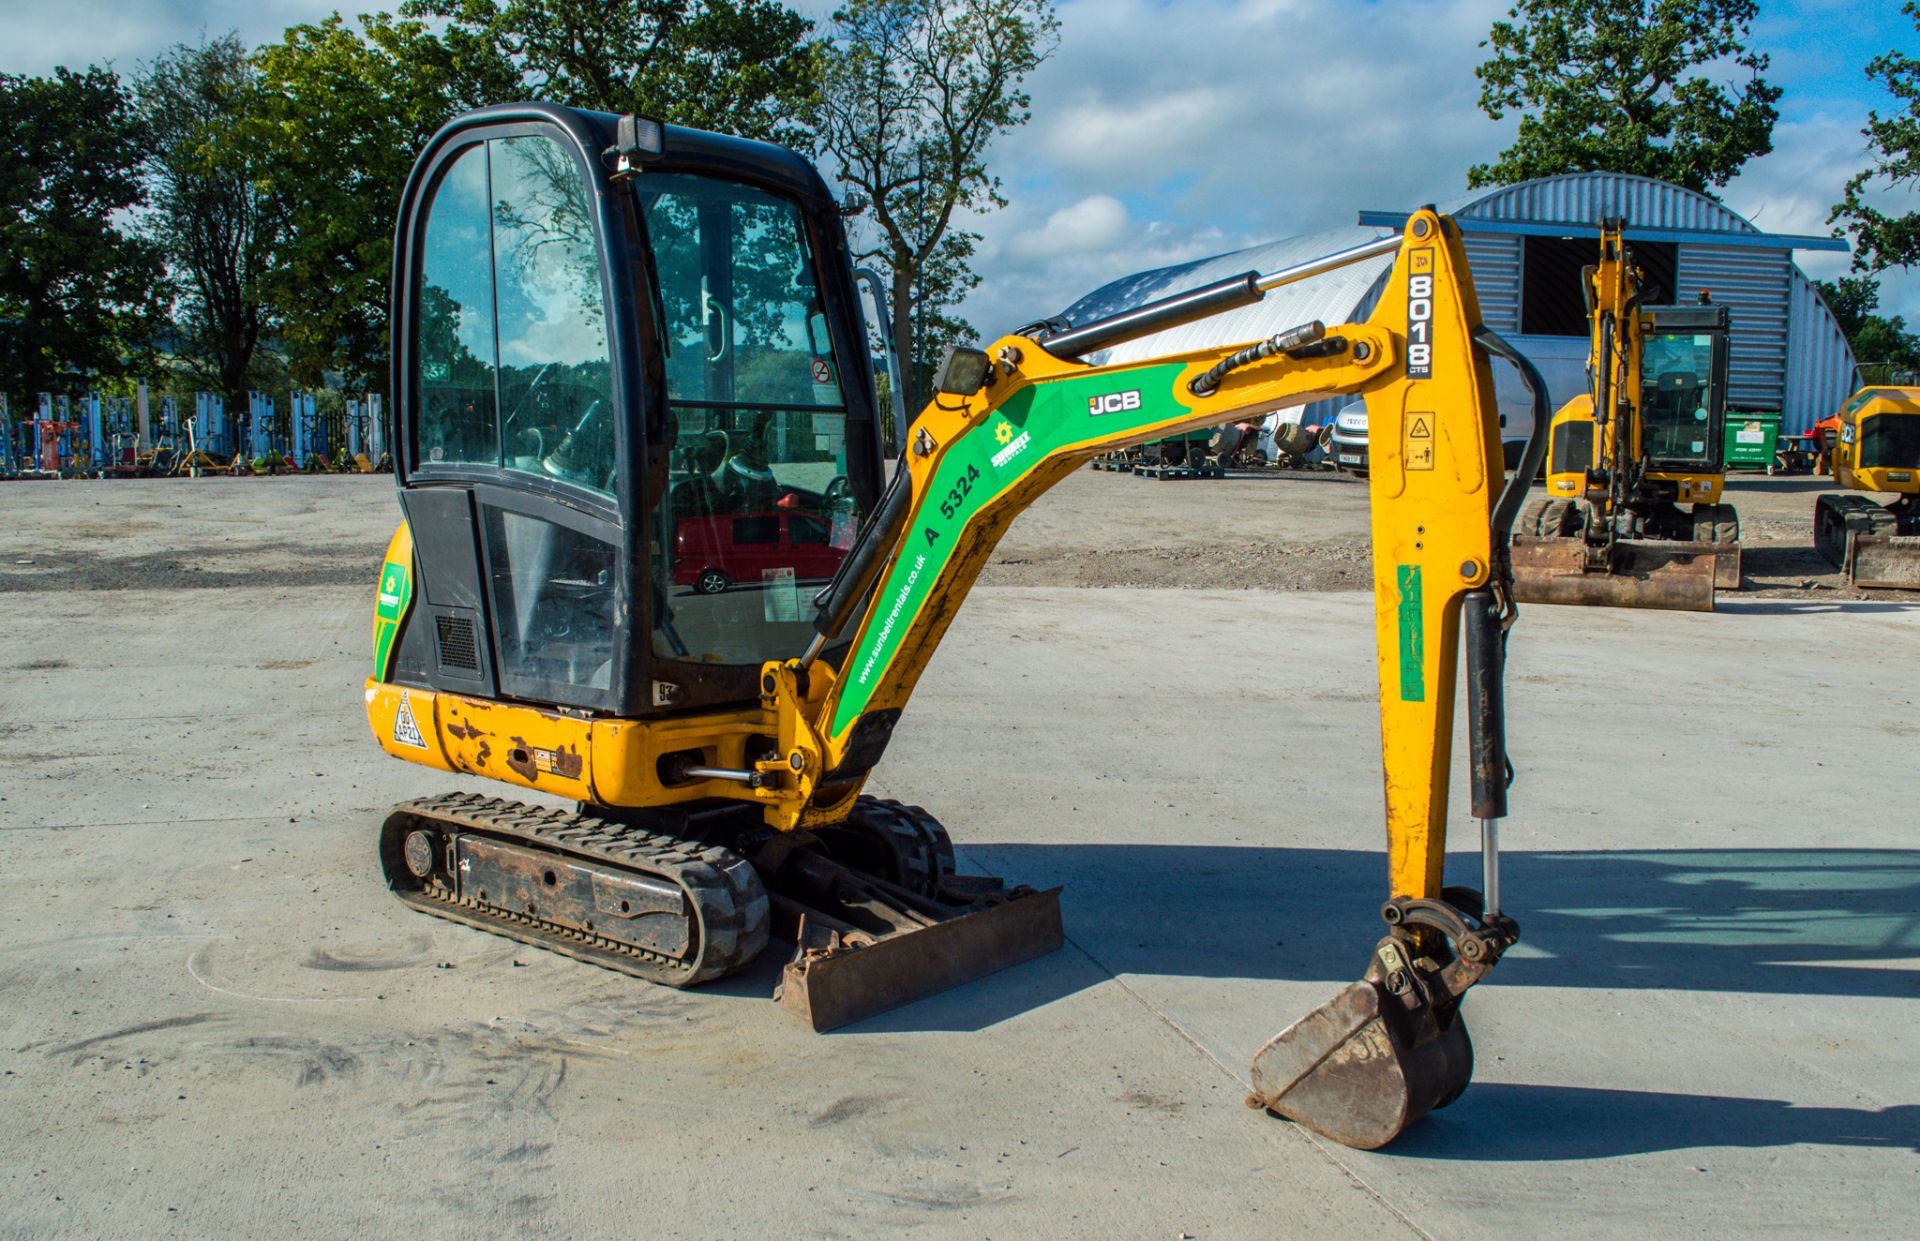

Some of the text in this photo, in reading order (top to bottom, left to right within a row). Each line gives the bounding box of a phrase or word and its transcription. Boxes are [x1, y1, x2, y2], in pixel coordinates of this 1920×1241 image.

[1408, 276, 1432, 366] 8018
[1409, 366, 1429, 374] CTS
[1089, 390, 1141, 415] JCB
[991, 430, 1031, 467] SUNBELT
[924, 464, 980, 548] A 5324
[859, 554, 926, 684] www.sunbeltrentals.co.uk
